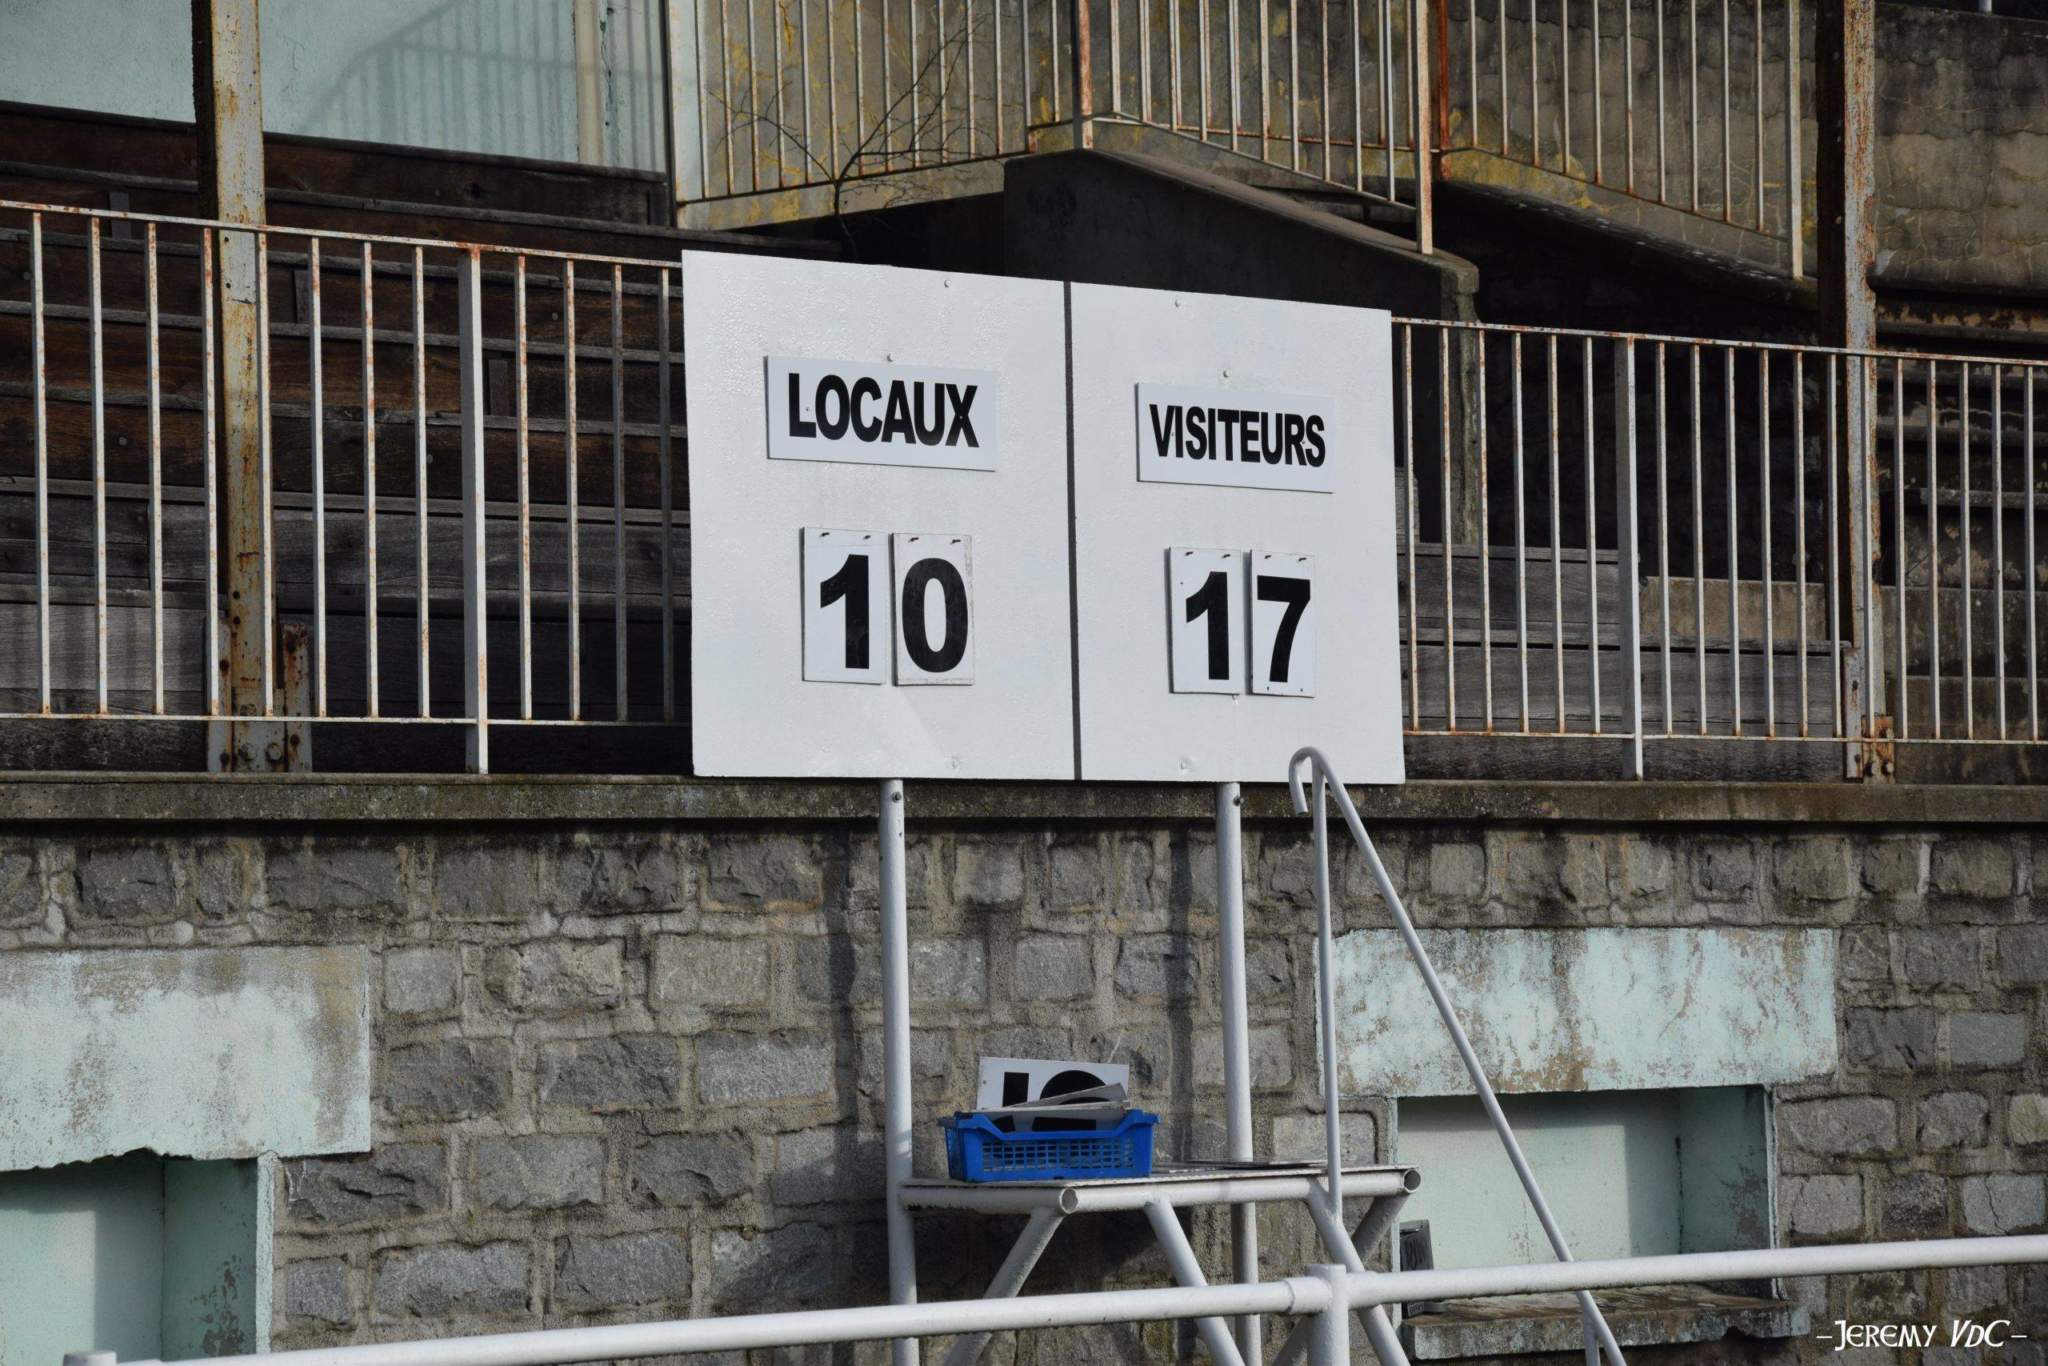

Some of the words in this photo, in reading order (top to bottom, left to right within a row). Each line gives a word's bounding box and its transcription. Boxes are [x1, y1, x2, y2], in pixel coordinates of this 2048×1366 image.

[788, 372, 980, 448] LOCAUX
[1149, 403, 1326, 467] VISITEURS
[820, 554, 968, 673] 10
[1185, 571, 1311, 683] 17
